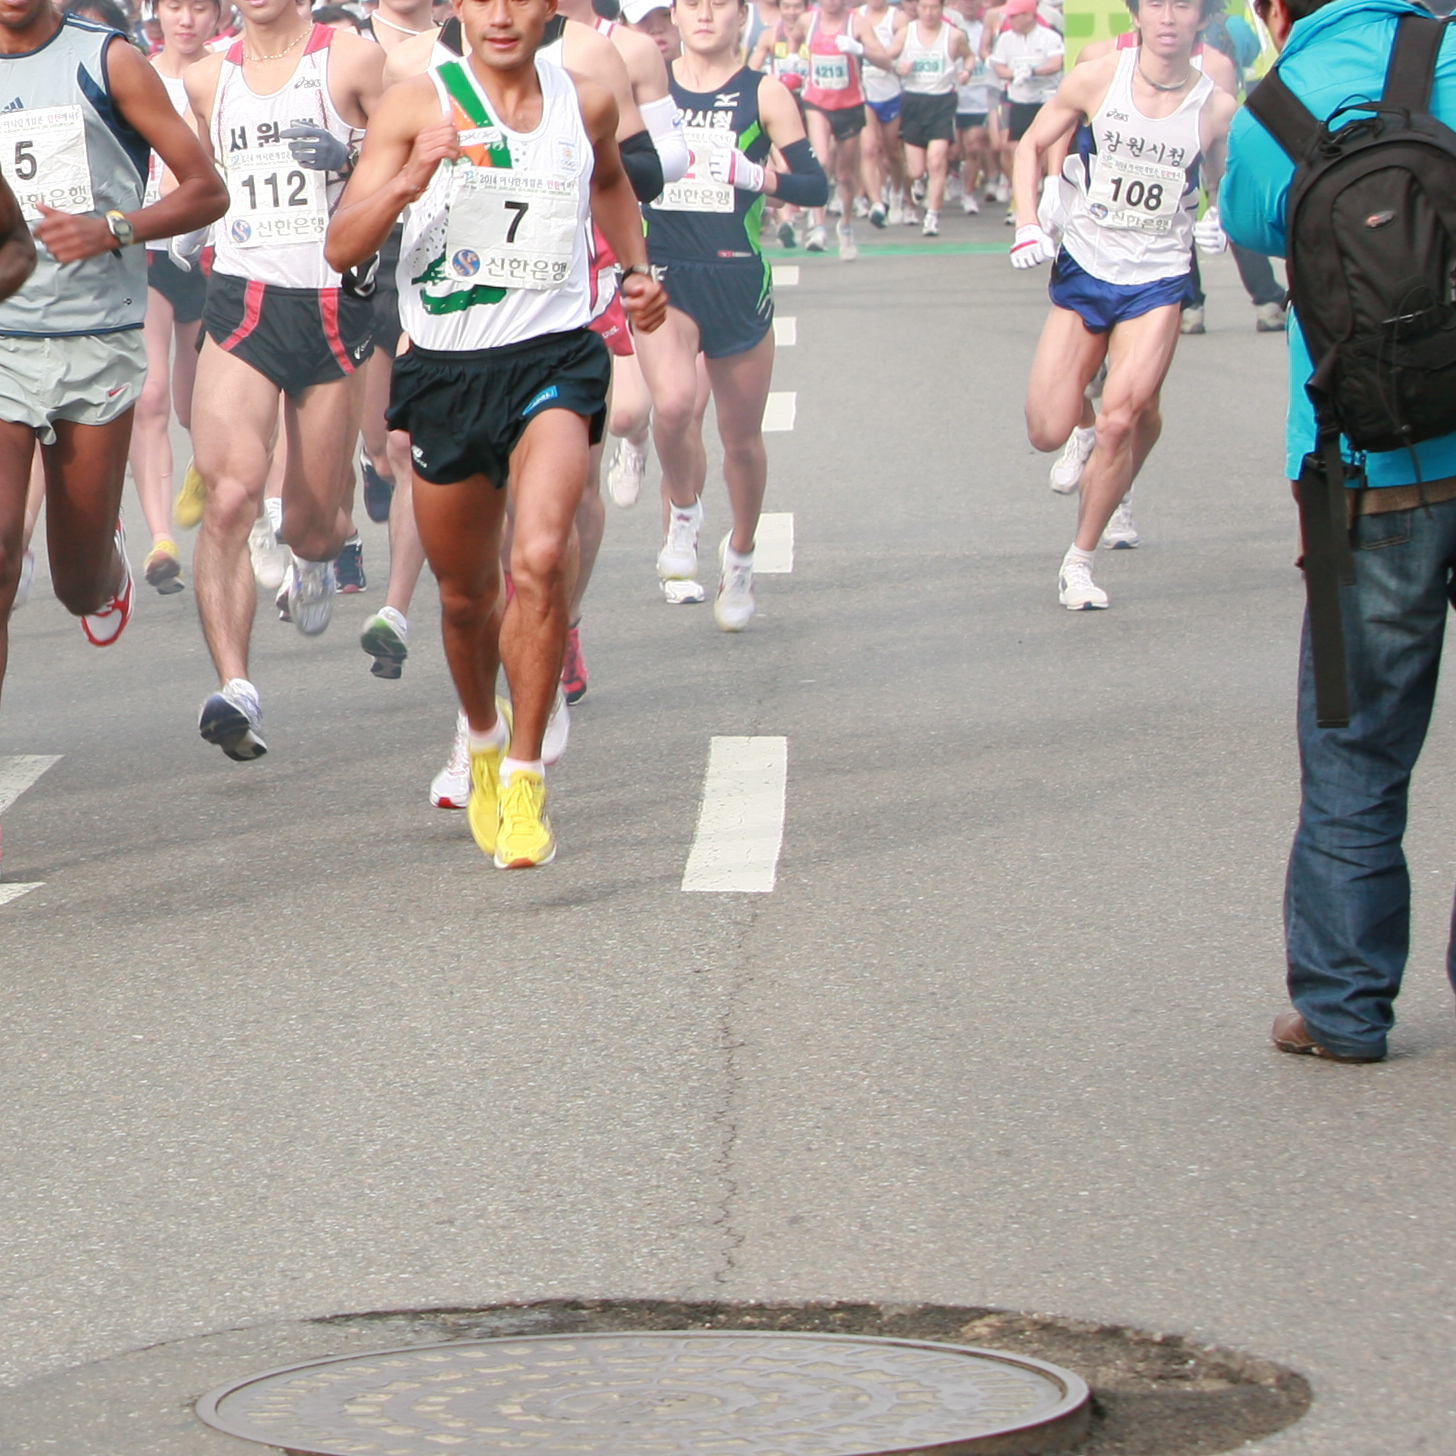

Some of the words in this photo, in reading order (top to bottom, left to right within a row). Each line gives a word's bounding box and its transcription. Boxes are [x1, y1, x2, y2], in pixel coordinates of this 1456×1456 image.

[230, 118, 315, 153] 서원
[1102, 129, 1185, 168] 창원시청
[14, 140, 38, 181] 5
[241, 169, 308, 210] 112
[667, 188, 731, 205] 신한은행
[1111, 176, 1164, 211] 108
[256, 216, 325, 238] 신한은행
[504, 200, 529, 243] 7
[485, 256, 568, 281] 신한은행
